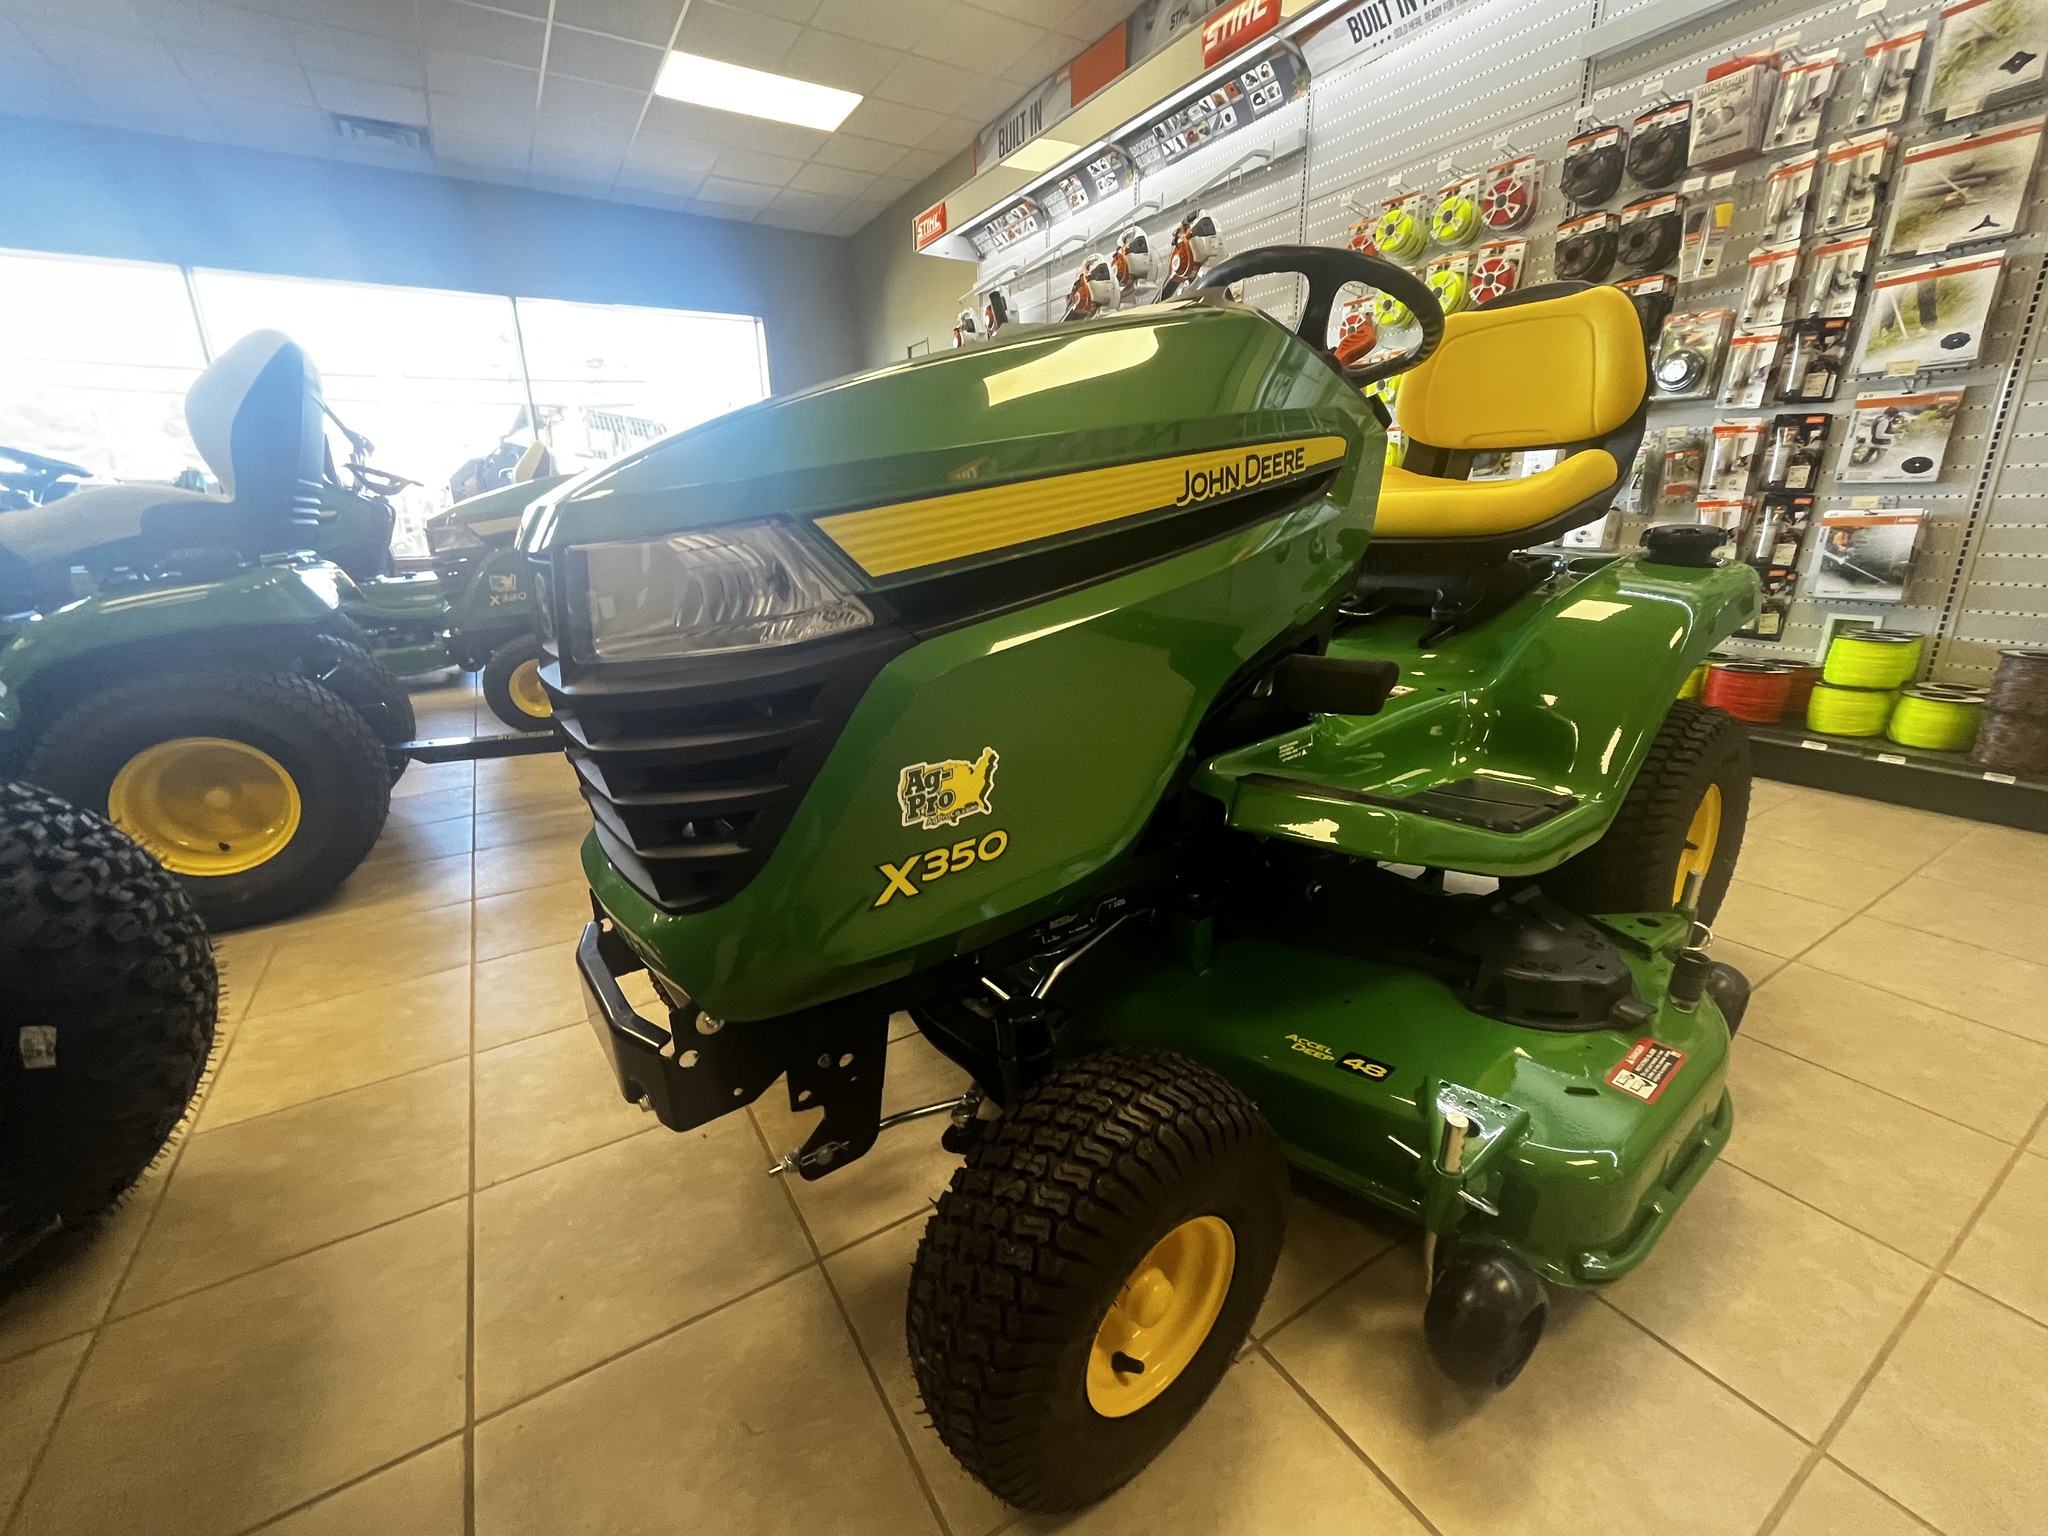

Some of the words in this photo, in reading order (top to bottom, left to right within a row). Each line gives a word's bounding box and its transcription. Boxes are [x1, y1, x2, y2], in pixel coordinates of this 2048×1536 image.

[1204, 0, 1267, 51] STIHL
[1346, 0, 1393, 44] BUILT
[998, 109, 1027, 159] BUILT
[1029, 97, 1042, 137] IN
[917, 213, 942, 236] STIHL
[1176, 463, 1240, 506] JOHN
[1245, 447, 1306, 487] DEERE
[904, 765, 953, 796] Ag-
[905, 790, 956, 822] Pro
[873, 830, 1008, 907] X350
[1284, 1033, 1333, 1055] ACCEL
[1291, 1042, 1335, 1061] DEEP
[1343, 1058, 1388, 1077] 48
